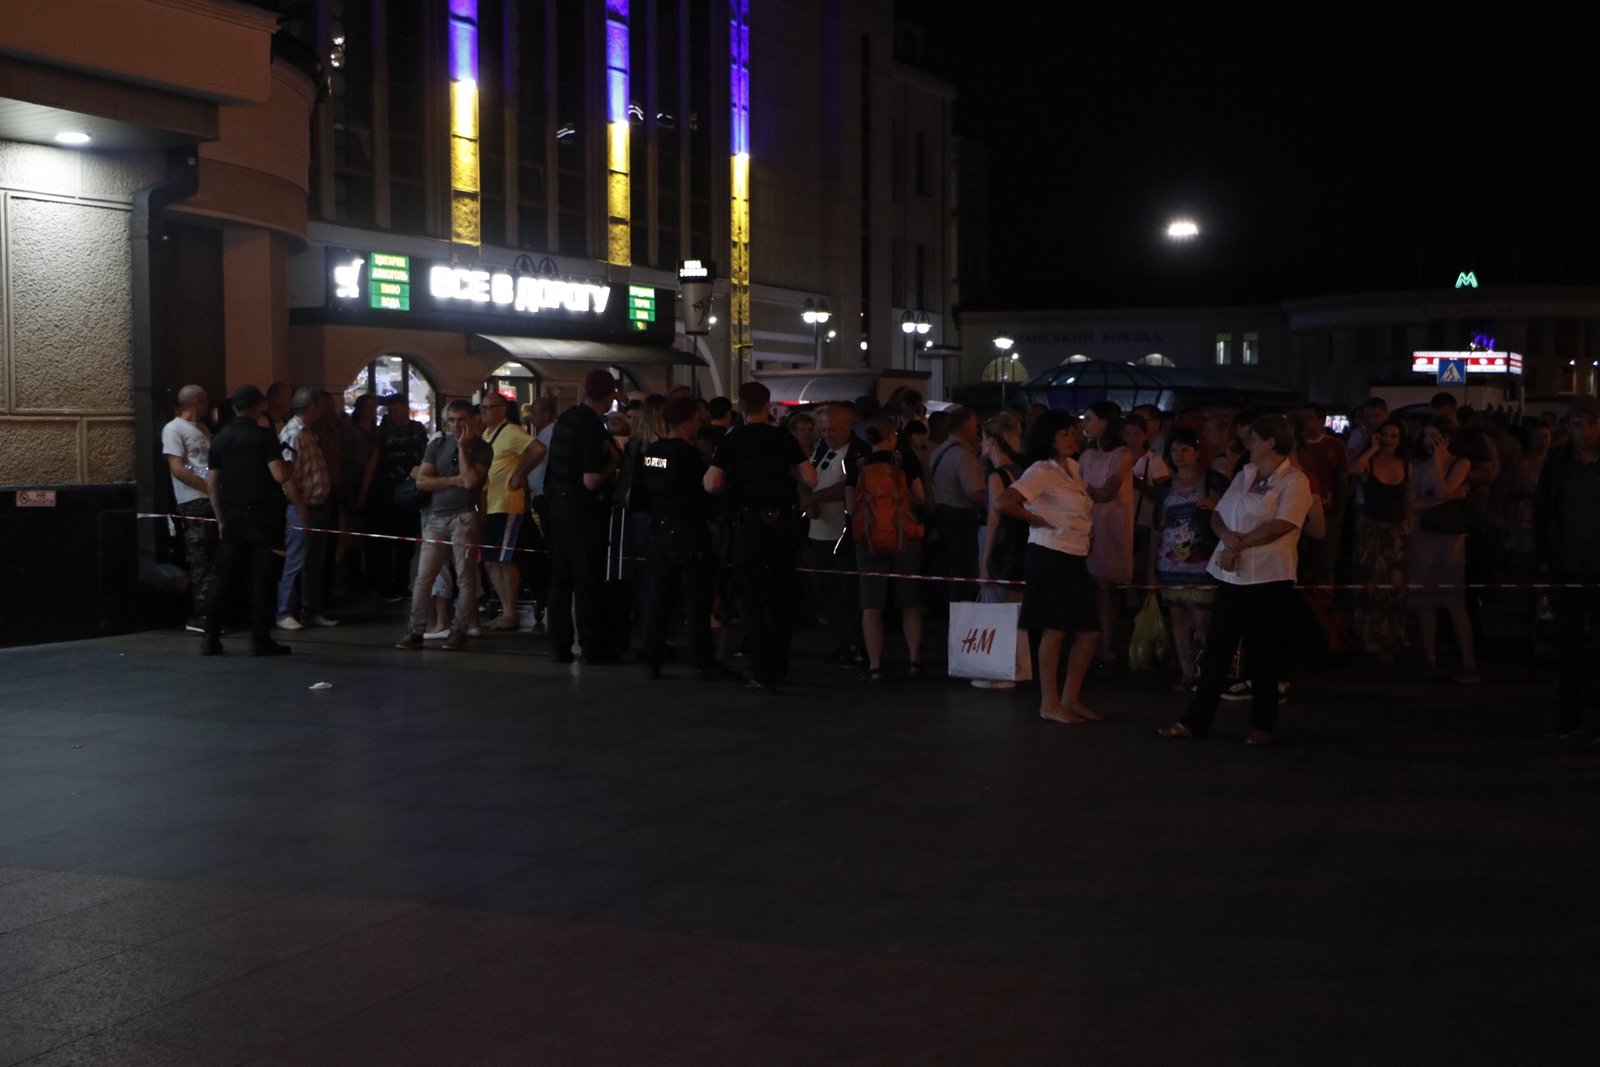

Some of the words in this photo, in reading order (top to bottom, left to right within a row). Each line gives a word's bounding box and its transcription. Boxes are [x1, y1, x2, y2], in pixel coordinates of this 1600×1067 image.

[430, 266, 490, 302] ВСЕ
[491, 273, 514, 304] В
[515, 277, 611, 313] ДОРОГУ
[1102, 330, 1163, 344] ВОКЗАЛ
[961, 628, 996, 655] H&M
